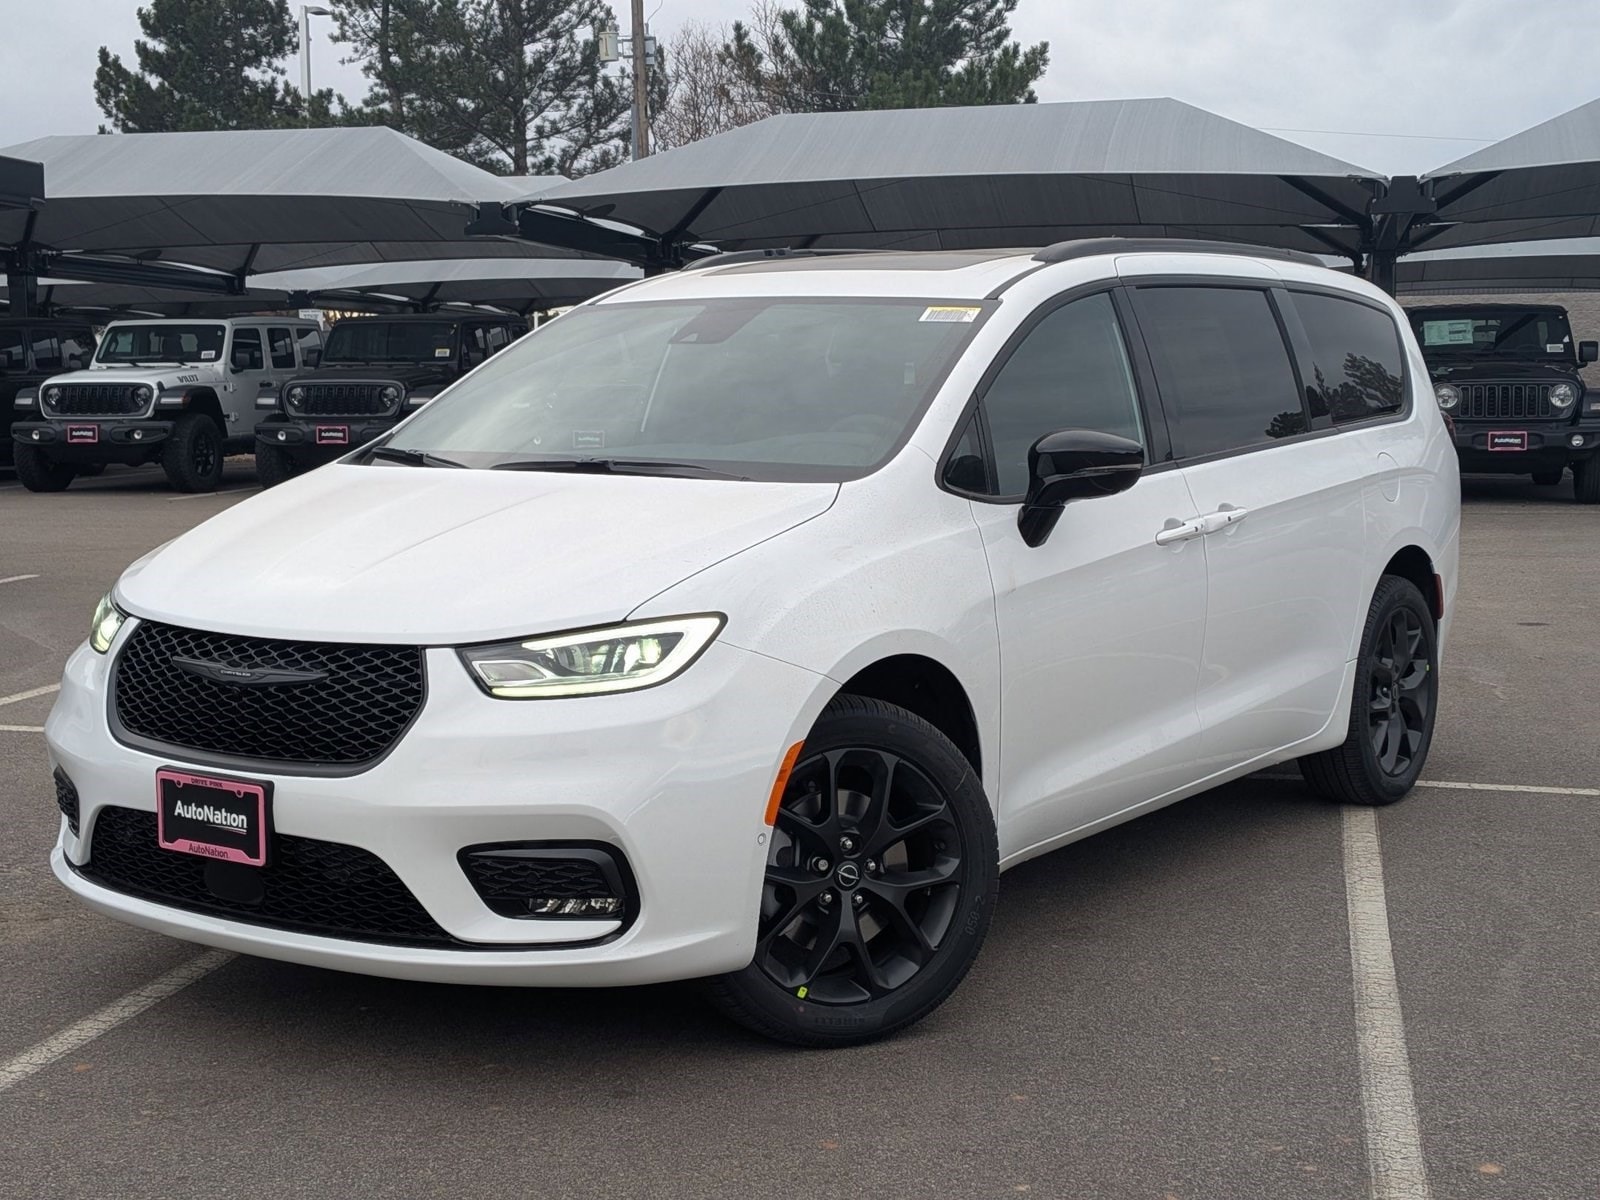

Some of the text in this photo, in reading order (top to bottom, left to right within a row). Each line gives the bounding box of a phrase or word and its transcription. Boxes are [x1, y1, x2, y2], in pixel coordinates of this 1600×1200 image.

[190, 778, 208, 786] DRIVE
[174, 800, 247, 829] AutoNation
[188, 843, 229, 859] AutoNation
